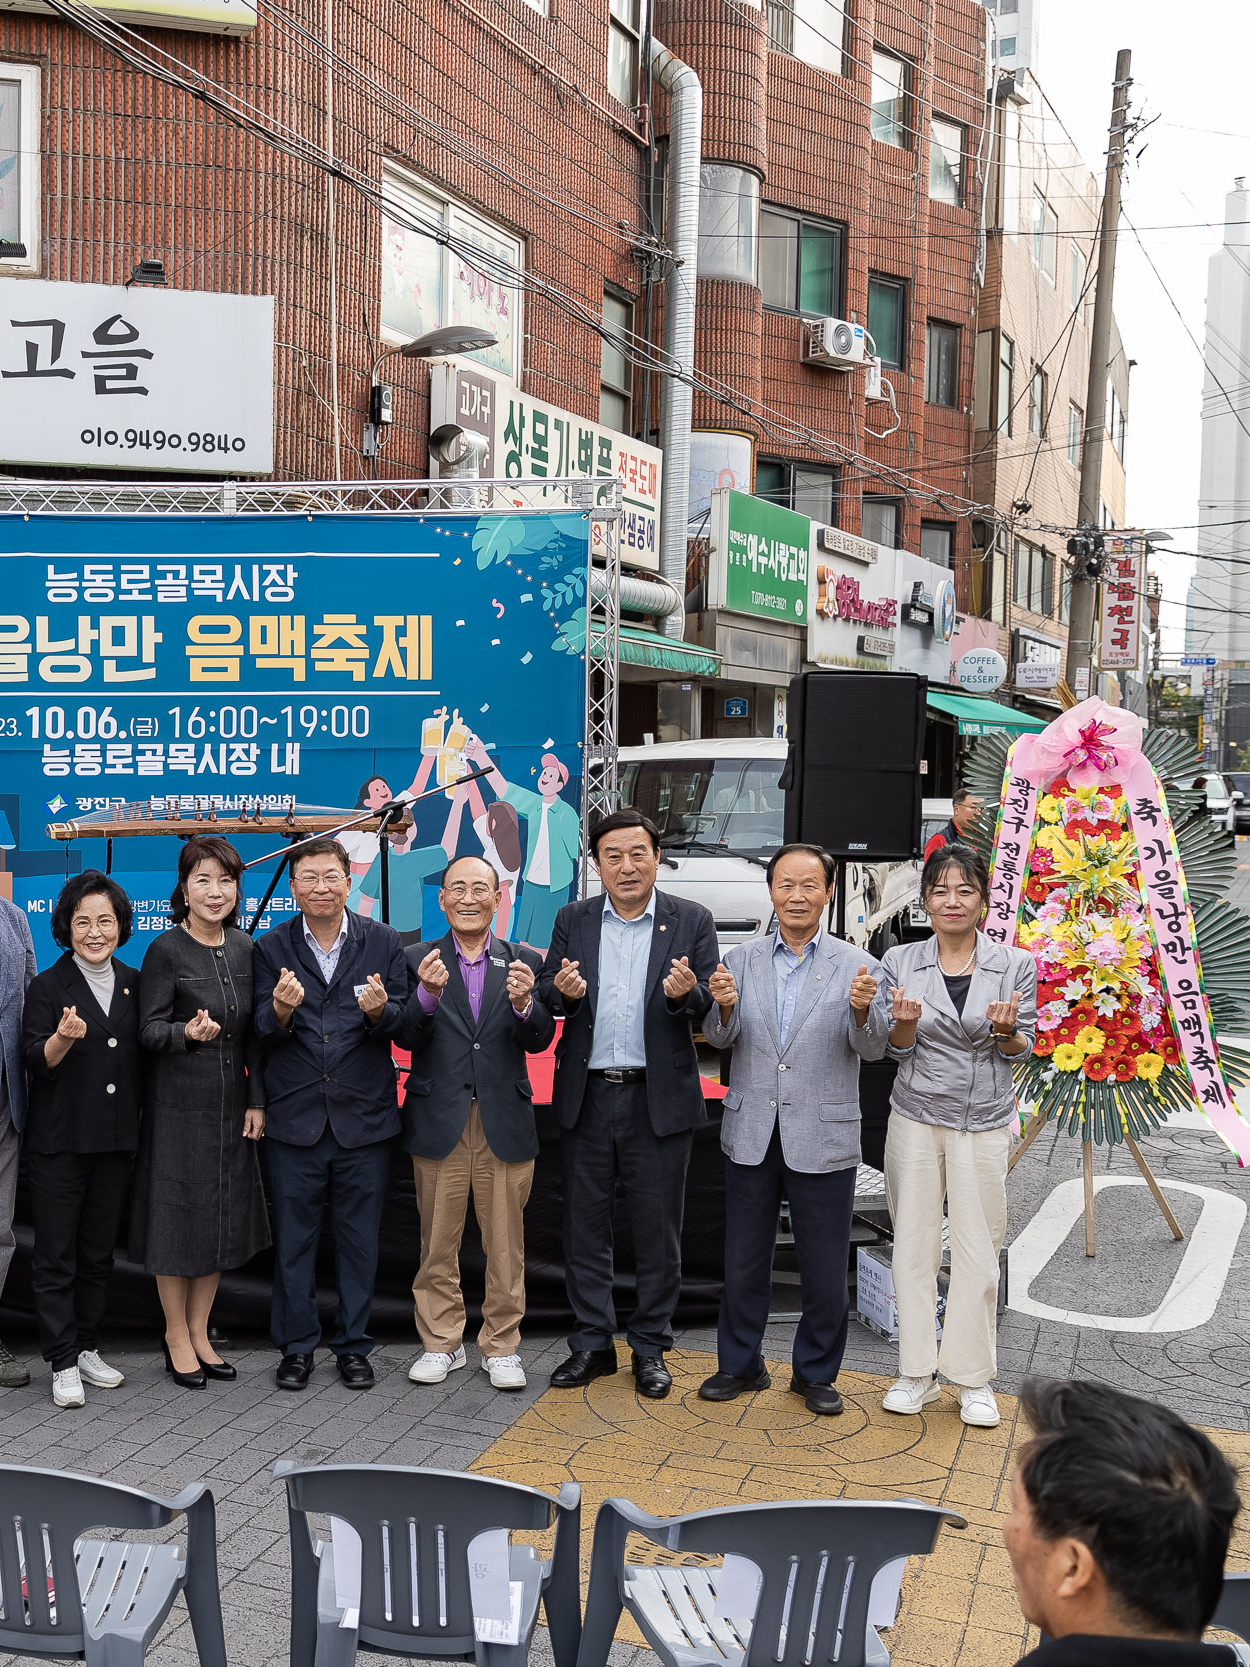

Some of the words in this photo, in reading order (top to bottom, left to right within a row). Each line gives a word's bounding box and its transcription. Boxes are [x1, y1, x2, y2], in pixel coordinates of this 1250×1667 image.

[459, 380, 491, 424] 고가구
[80, 426, 246, 454] 010.9490.9840
[618, 450, 657, 500] 전국도매
[747, 533, 808, 586] 예수사랑교회
[46, 564, 298, 604] 능동로골목시장
[1108, 558, 1136, 650] 김밥천국
[185, 613, 434, 684] 음맥축제
[963, 656, 997, 665] COFFEE
[960, 675, 1000, 684] DESSERT
[977, 666, 984, 674] &
[168, 704, 370, 740] 16:00~19:00
[731, 706, 741, 715] 25
[40, 742, 260, 776] 능동로골목시장
[270, 742, 300, 776] 내
[75, 796, 128, 810] 광진구
[1002, 776, 1036, 834] 광진구
[989, 841, 1021, 921] 전통시장
[27, 900, 46, 913] MC
[245, 897, 302, 912] 홍삼트리
